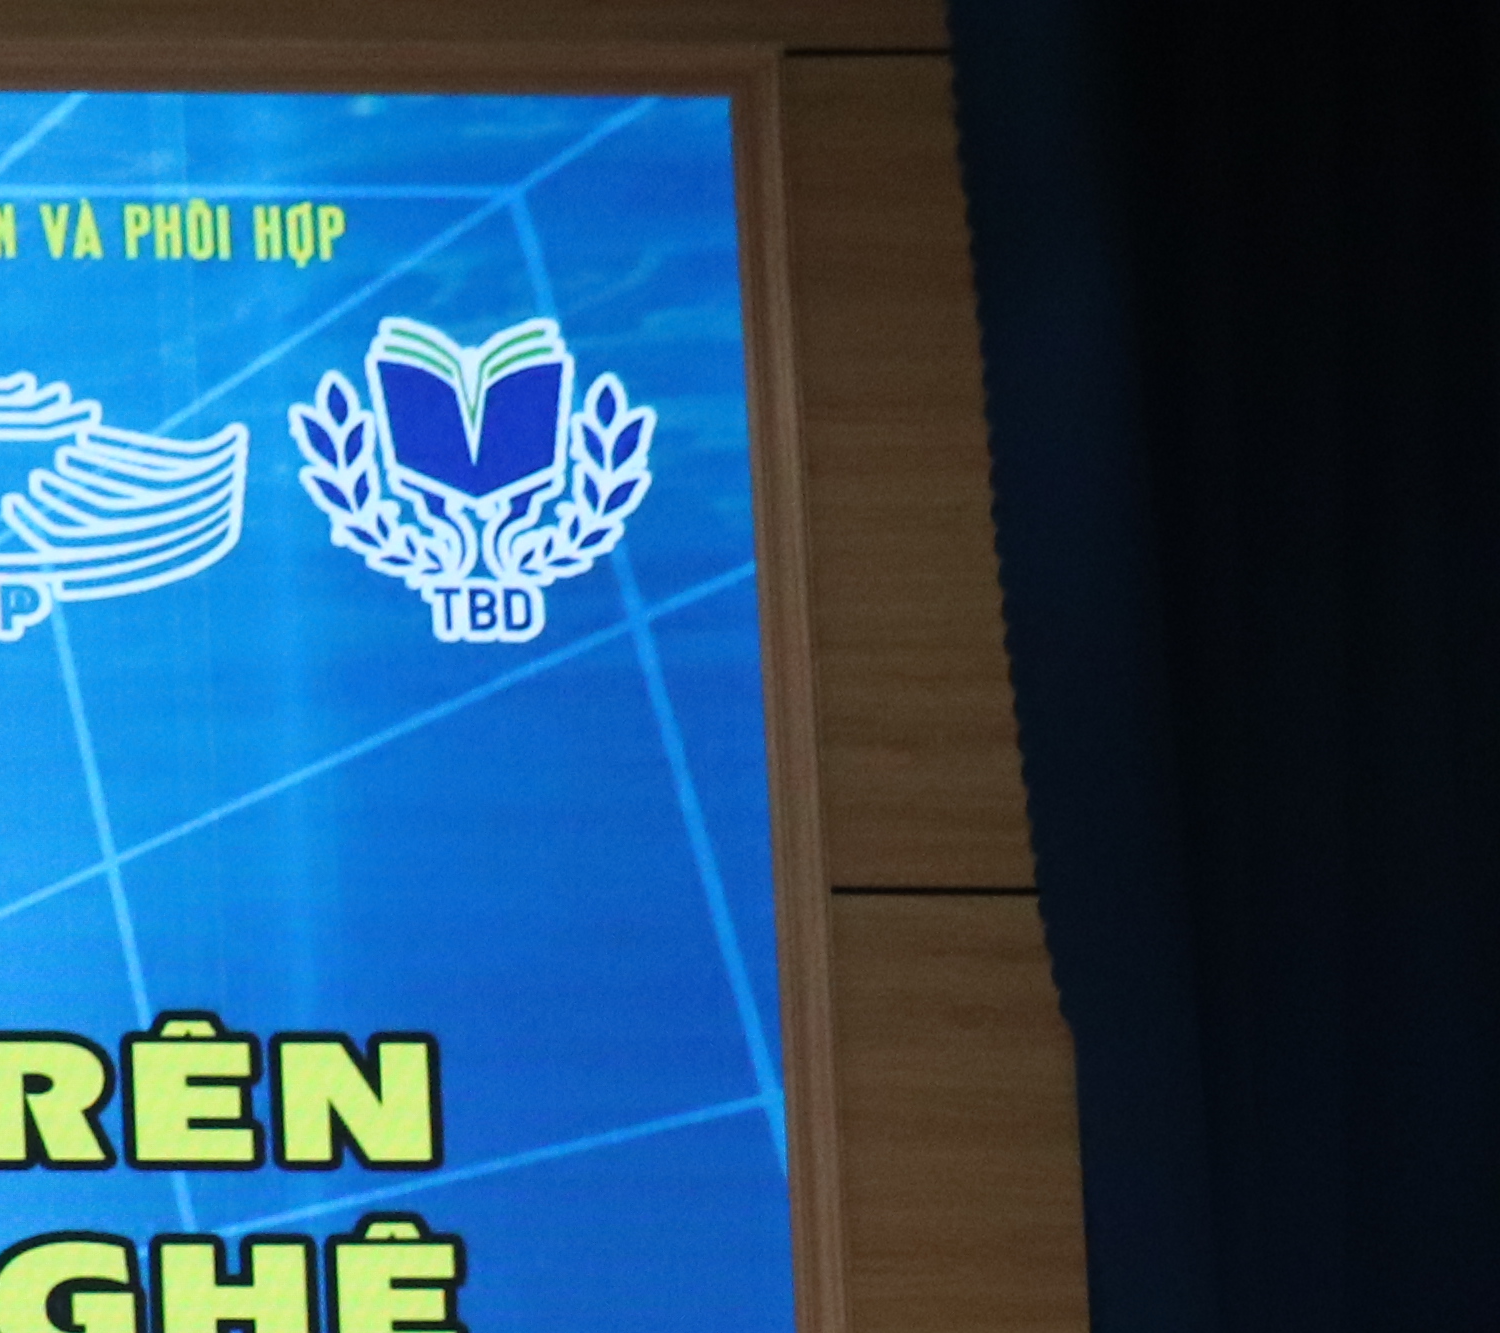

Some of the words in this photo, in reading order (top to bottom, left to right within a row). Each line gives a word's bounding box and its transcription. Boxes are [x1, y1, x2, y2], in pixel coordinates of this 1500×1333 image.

[40, 196, 101, 260] VÀ
[254, 198, 345, 267] HỢP
[431, 581, 544, 643] TBD
